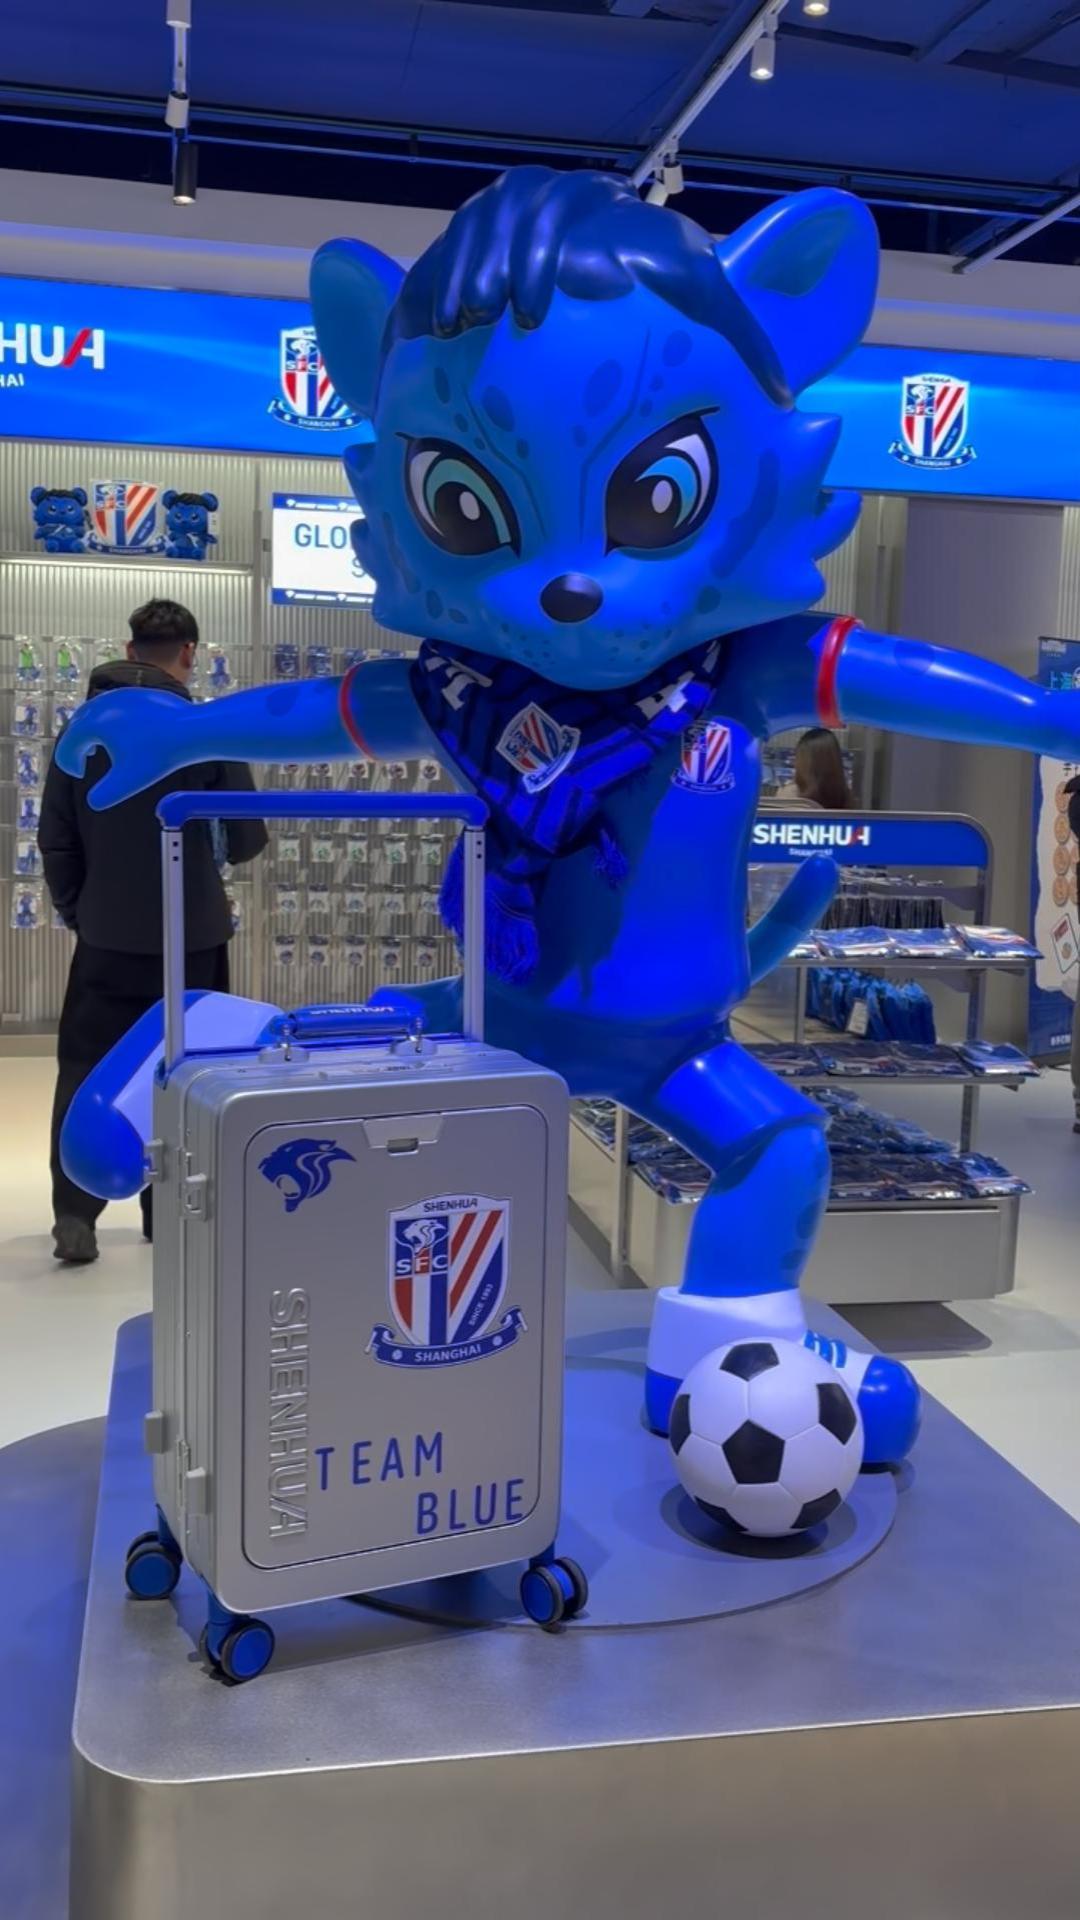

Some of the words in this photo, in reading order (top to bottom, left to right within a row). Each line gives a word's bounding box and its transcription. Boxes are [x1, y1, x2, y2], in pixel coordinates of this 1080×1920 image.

[752, 823, 871, 846] SHENHUA
[423, 1198, 478, 1213] SHENHUA
[395, 1254, 449, 1275] SFC
[414, 1343, 482, 1363] SHANGHAI
[269, 1287, 309, 1538] SHENHUA
[314, 1431, 443, 1491] TEAM
[416, 1478, 525, 1535] BLUE
